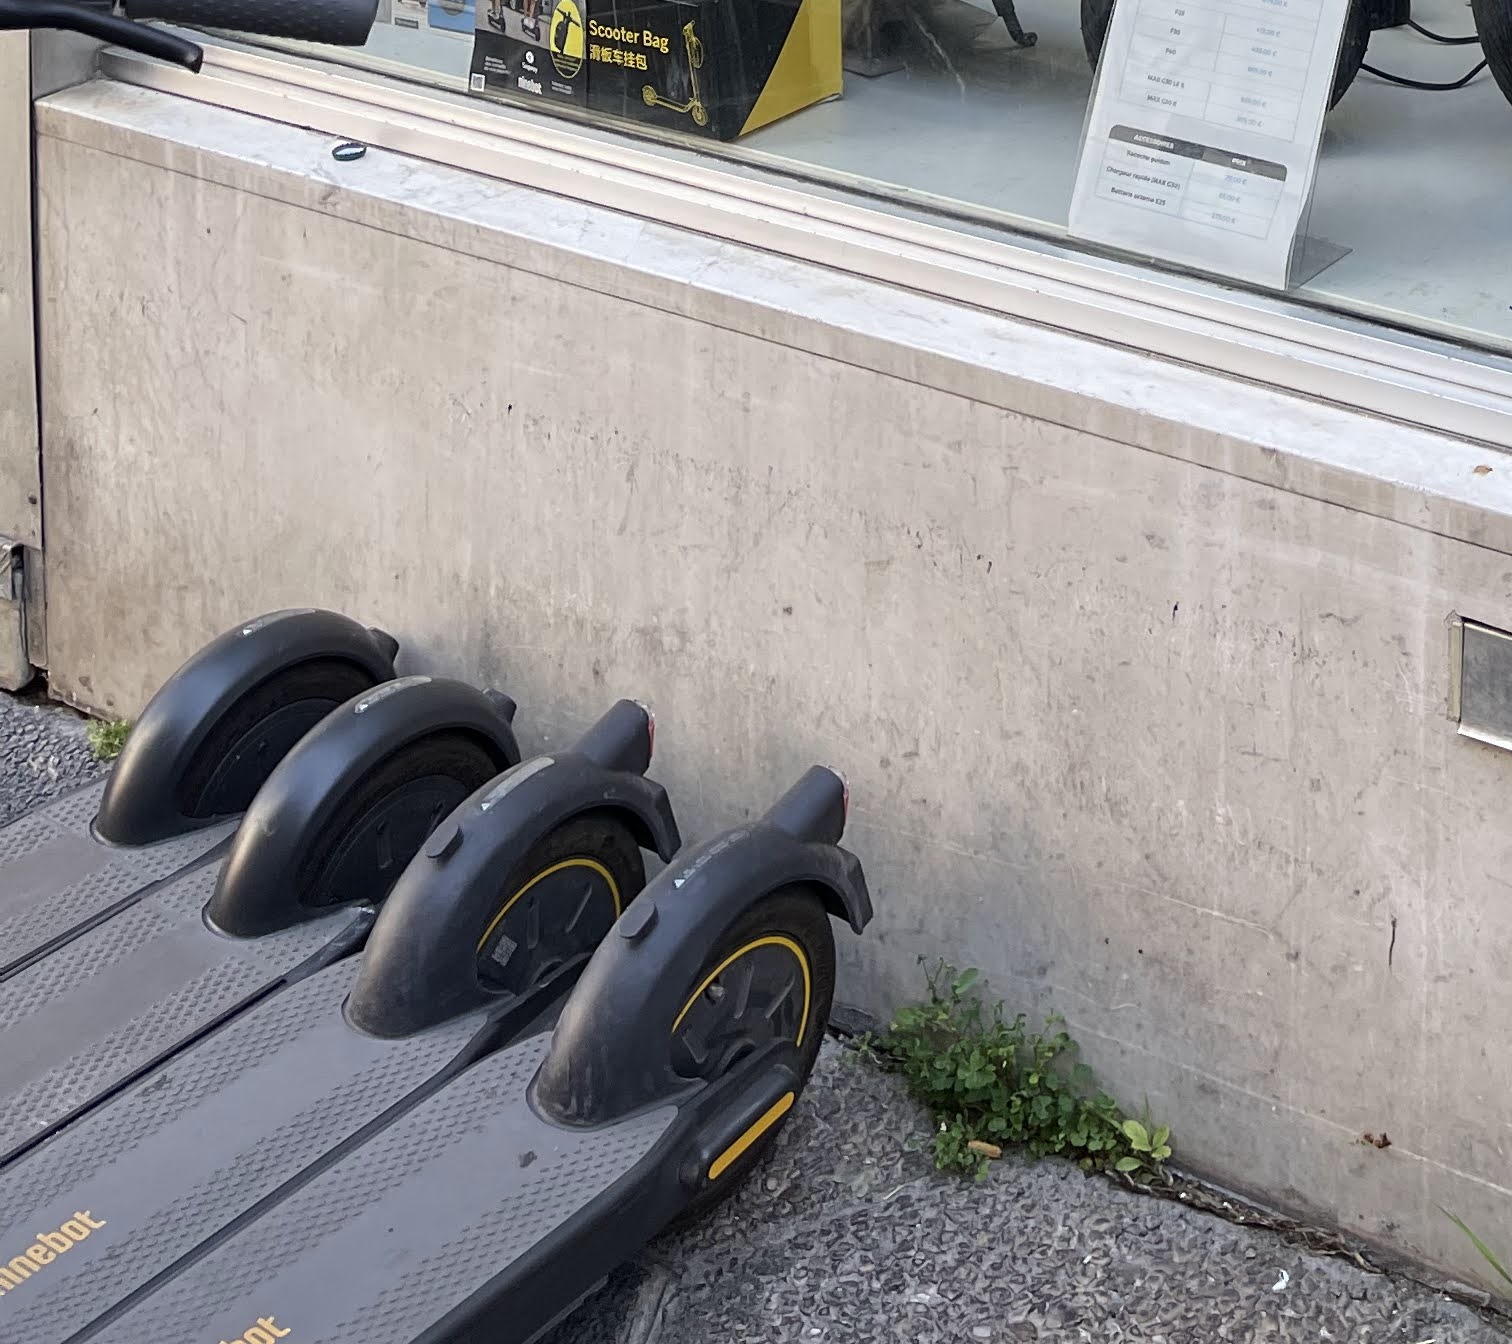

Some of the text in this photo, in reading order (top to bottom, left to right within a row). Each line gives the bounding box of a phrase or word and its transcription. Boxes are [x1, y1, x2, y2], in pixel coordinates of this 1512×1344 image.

[588, 18, 670, 55] Scooter Bag
[588, 43, 649, 71] 滑板车挂包
